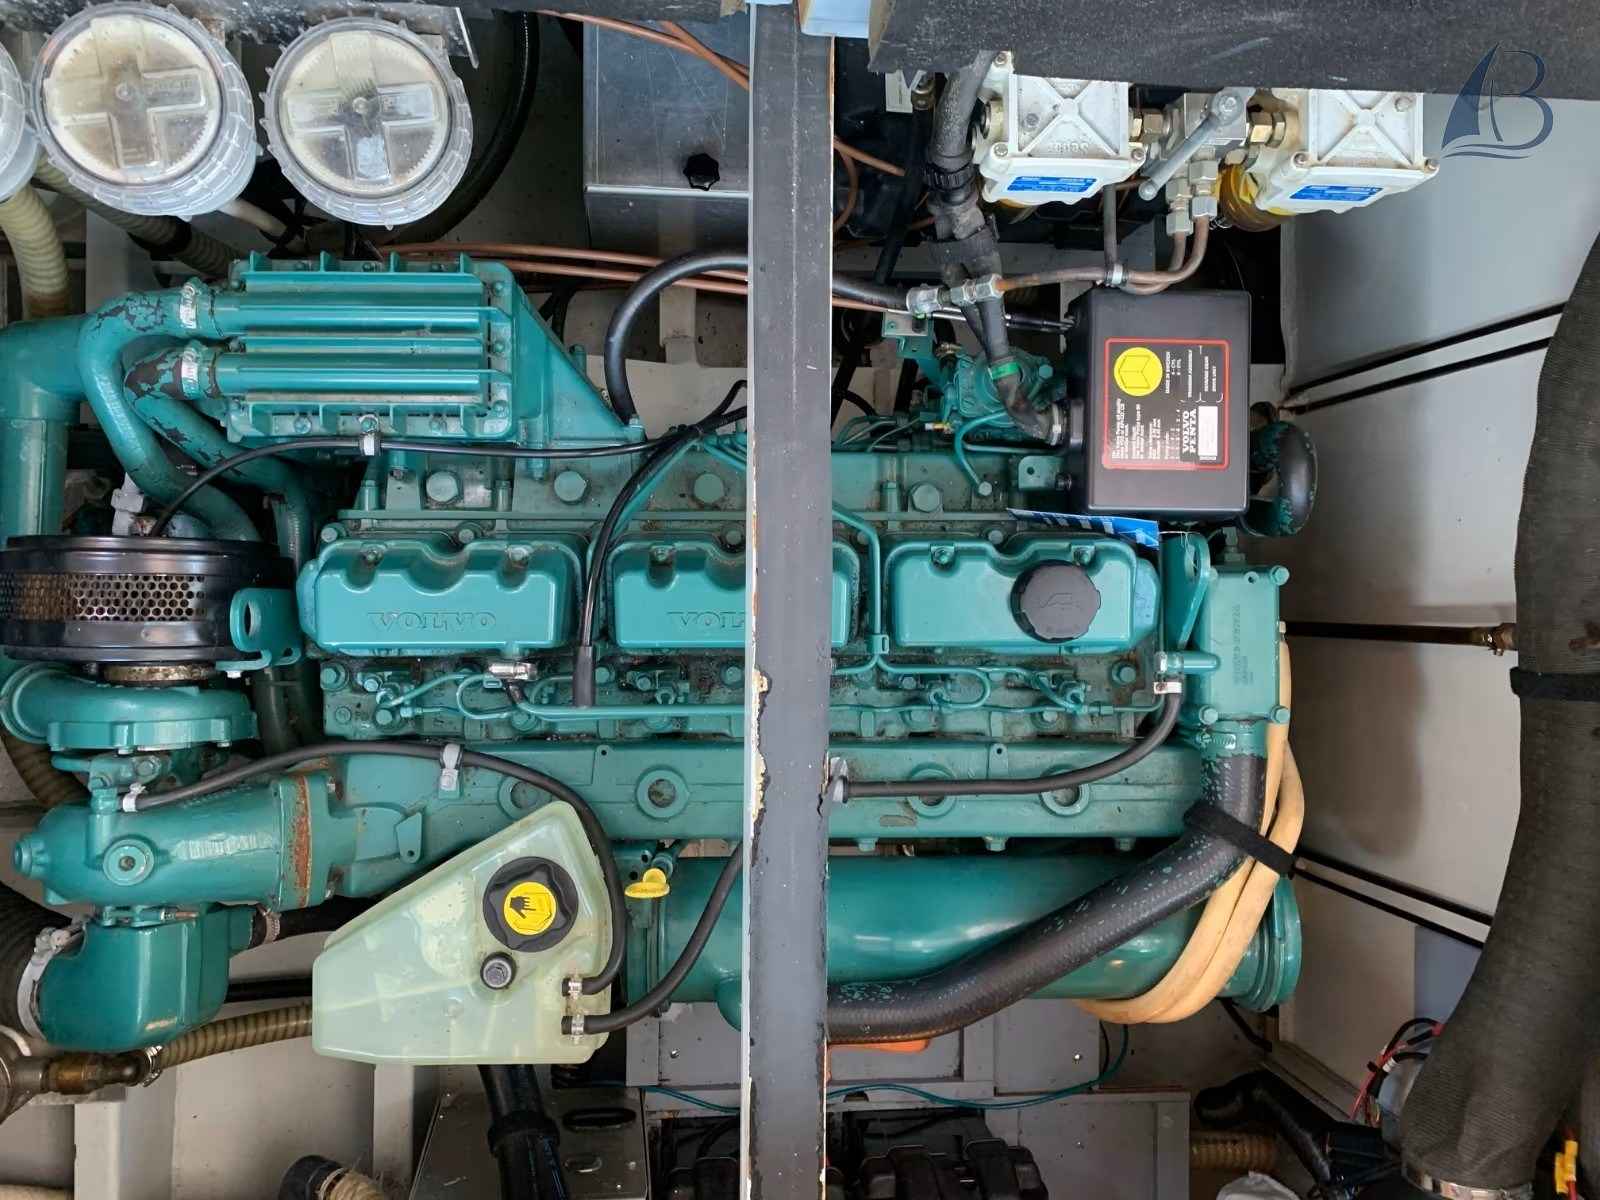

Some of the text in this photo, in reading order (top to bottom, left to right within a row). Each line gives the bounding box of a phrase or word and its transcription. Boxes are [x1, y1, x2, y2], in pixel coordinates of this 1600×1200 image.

[1182, 411, 1190, 453] VOLVO
[368, 611, 496, 630] VOLVO
[667, 611, 746, 629] VOL
